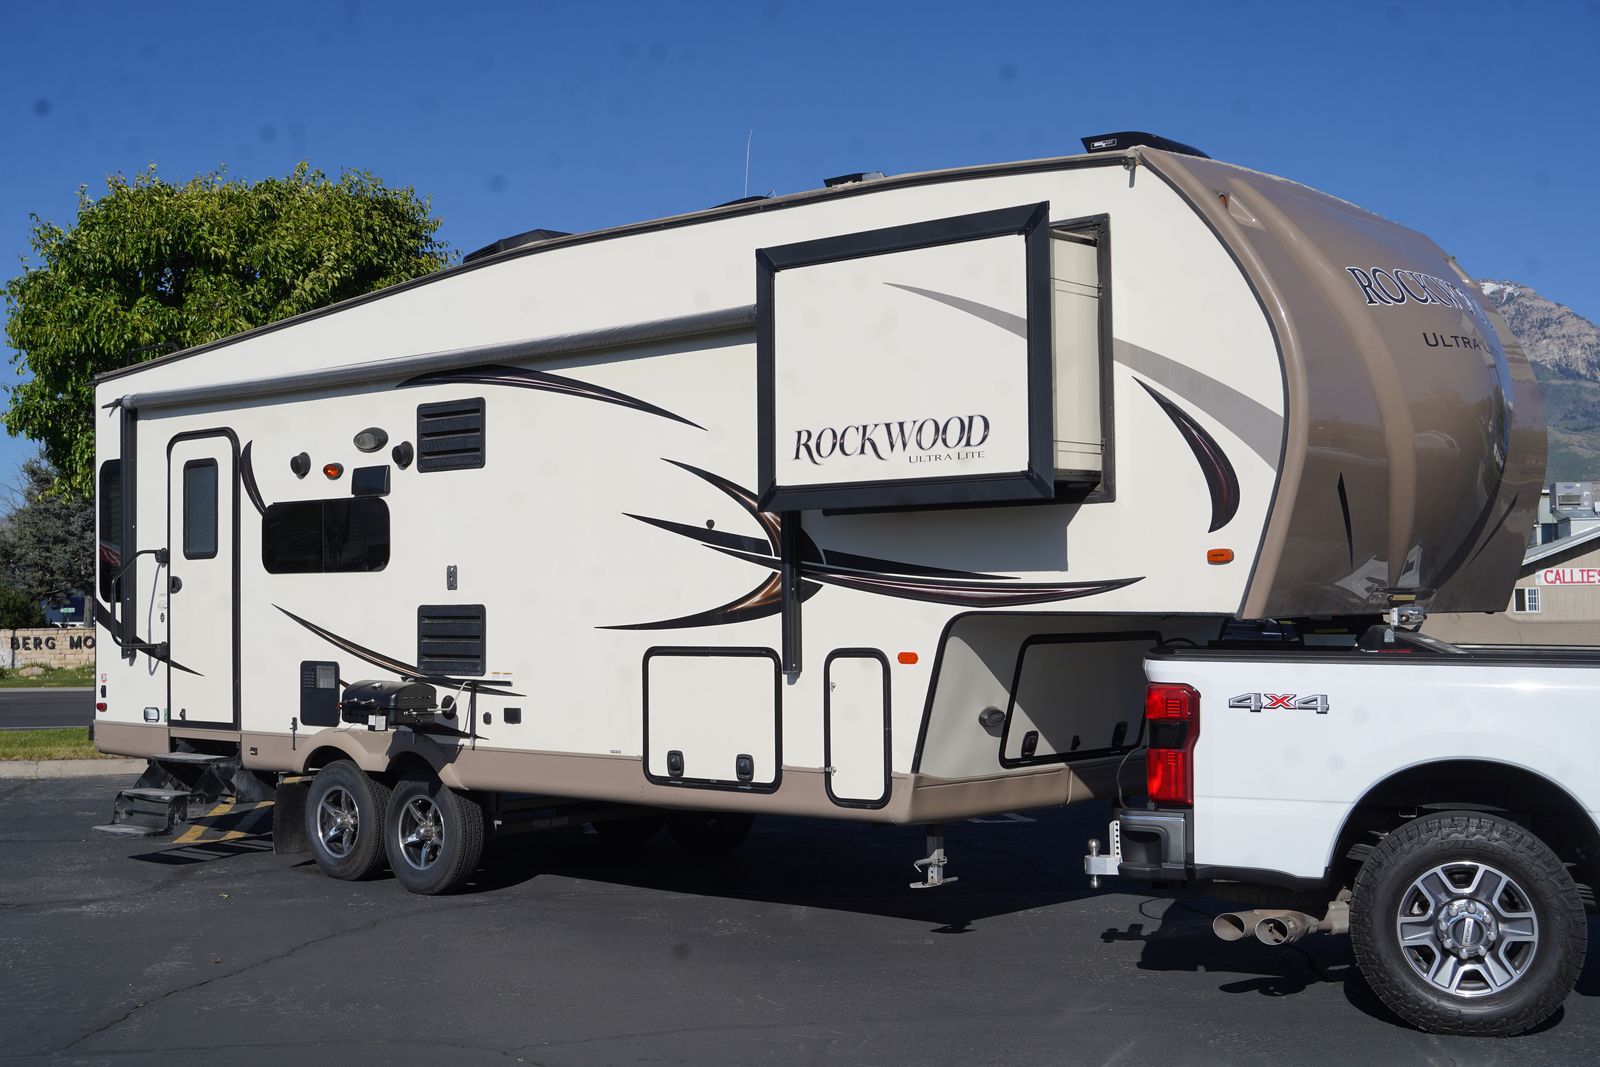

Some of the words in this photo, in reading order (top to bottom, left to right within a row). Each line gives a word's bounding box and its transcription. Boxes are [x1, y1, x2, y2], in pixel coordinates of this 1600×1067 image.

[1422, 332, 1482, 351] ULTRA
[792, 414, 990, 466] ROCKWOOD
[908, 453, 953, 464] ULTRA
[957, 450, 986, 461] LITE
[10, 635, 56, 651] BERG
